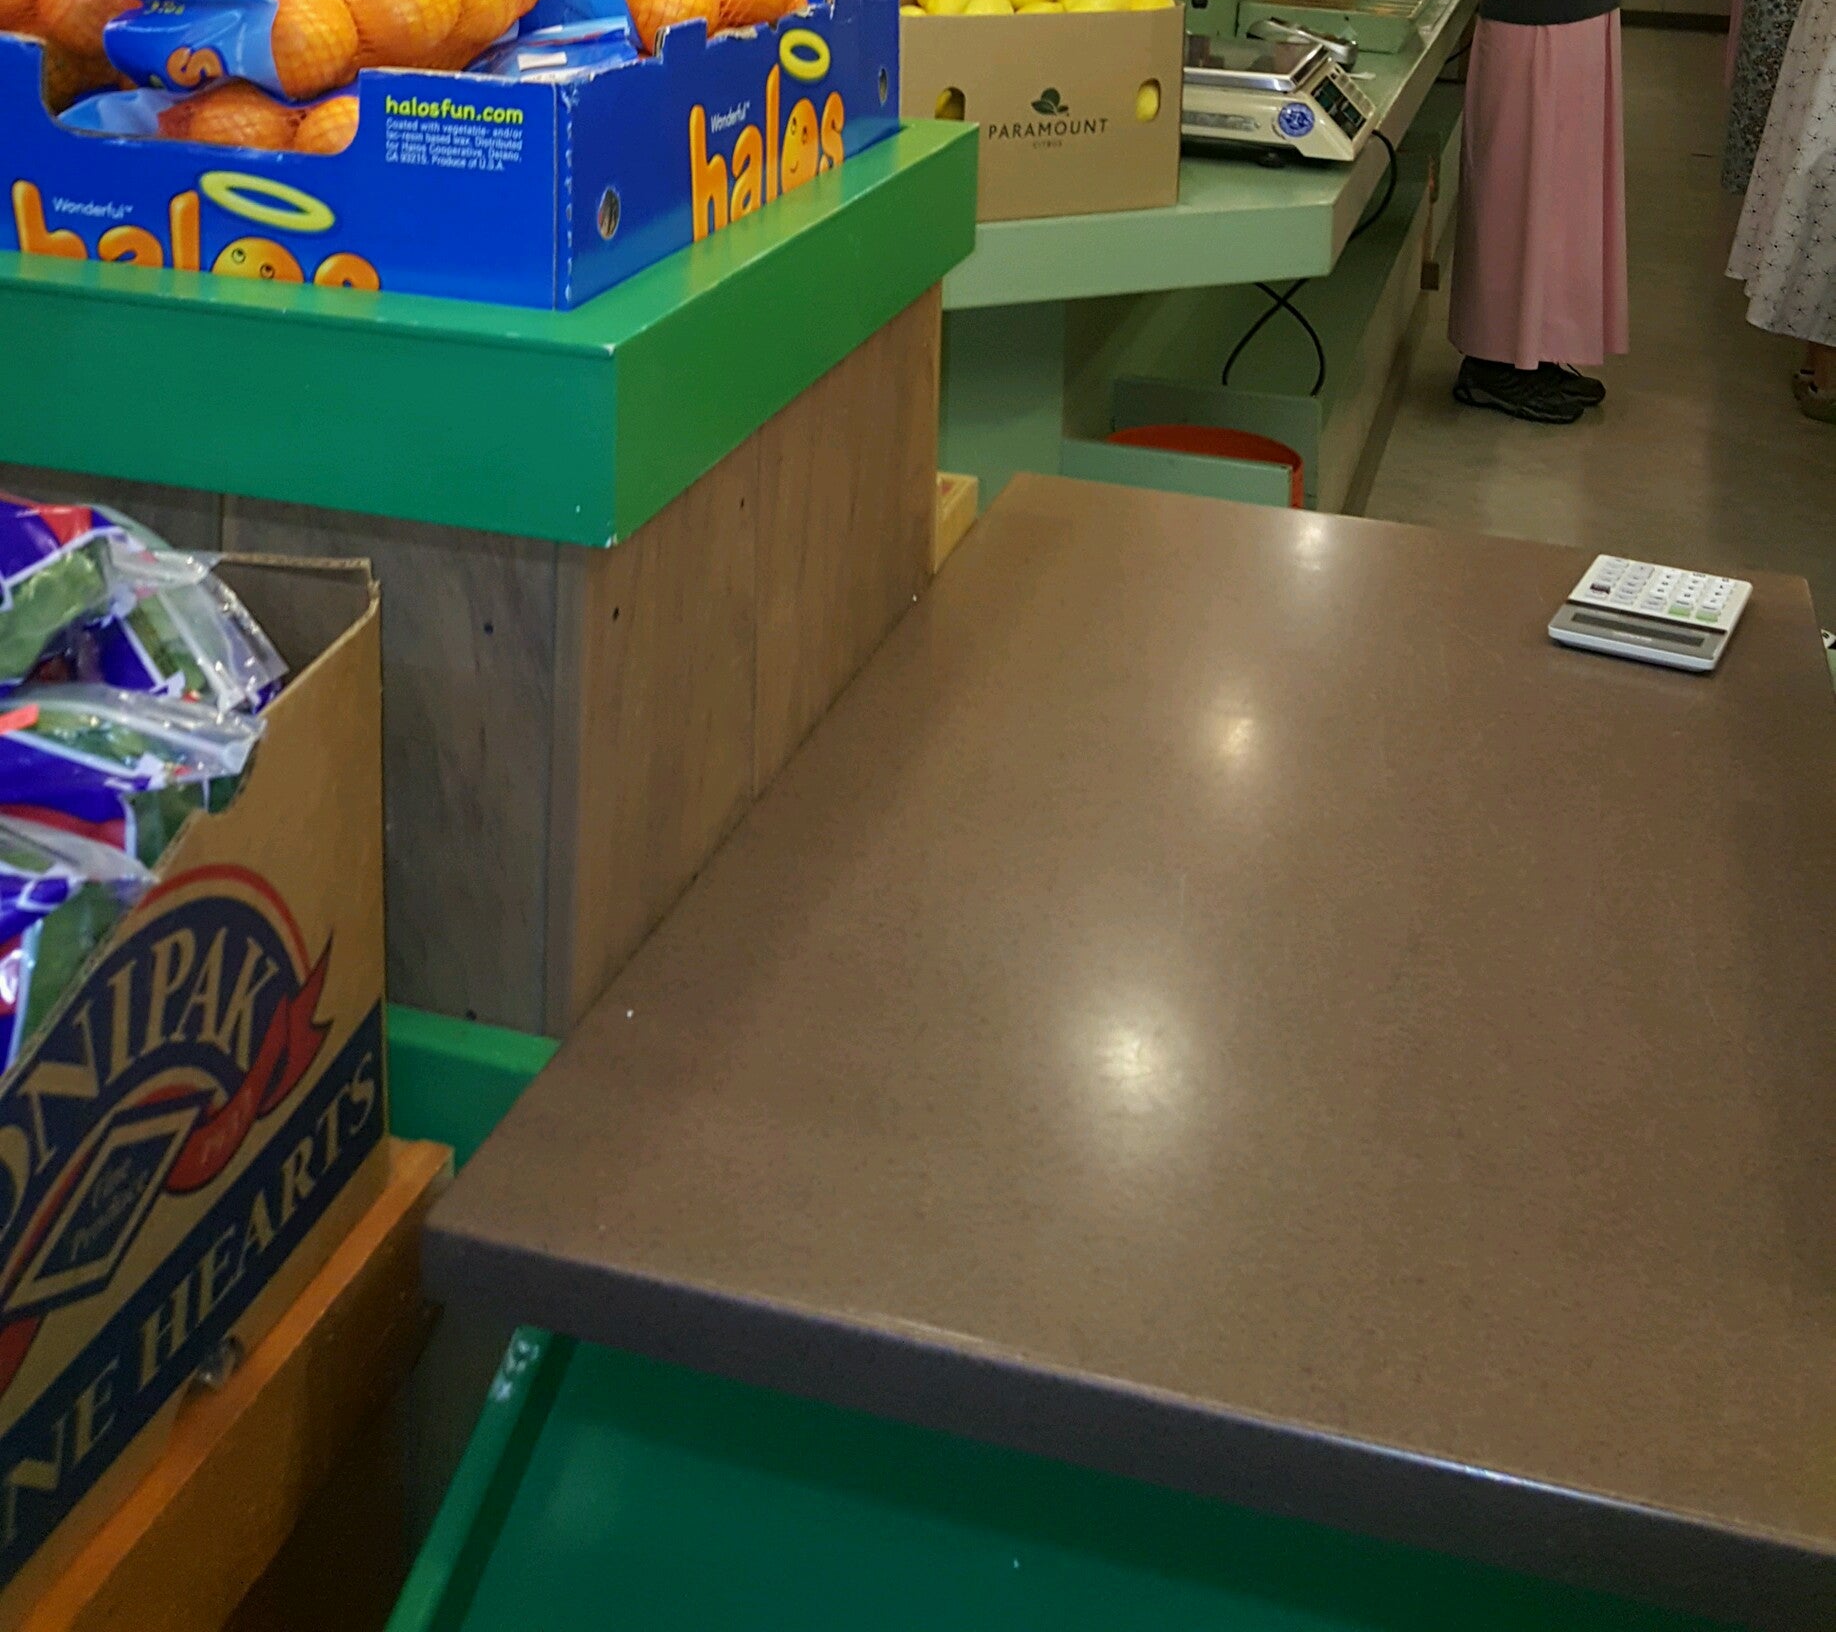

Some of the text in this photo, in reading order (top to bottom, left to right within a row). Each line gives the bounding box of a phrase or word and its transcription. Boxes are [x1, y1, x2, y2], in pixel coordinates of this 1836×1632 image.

[386, 94, 524, 125] halosfun.com
[420, 122, 440, 133] with
[988, 118, 1108, 140] PARAMOUNT
[138, 1050, 378, 1393] HEARTS
